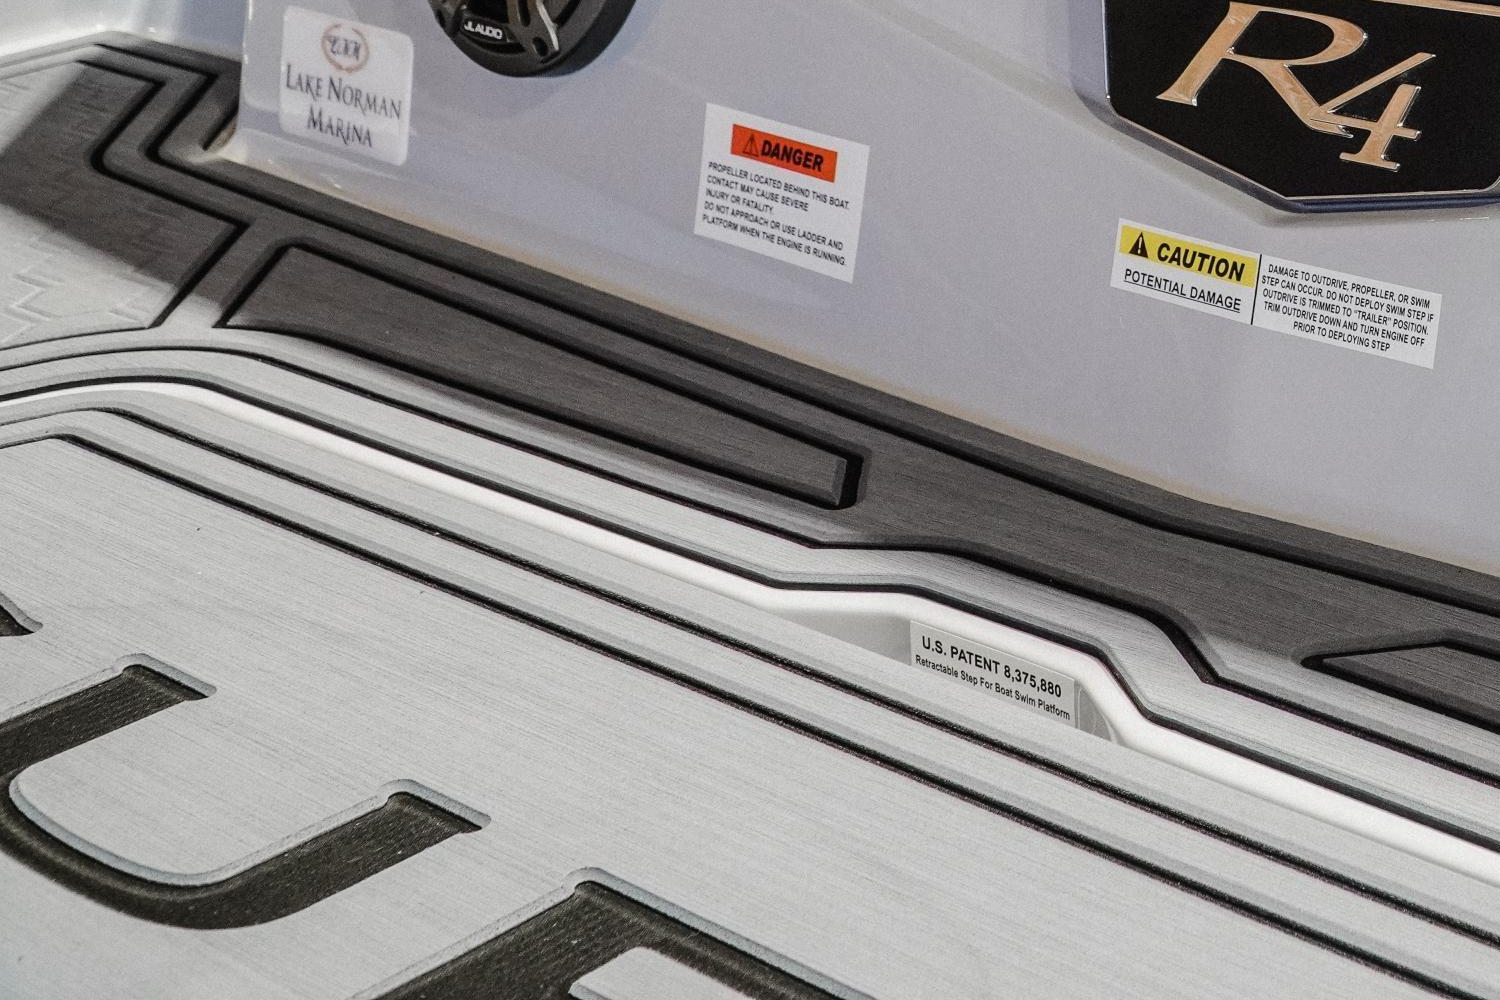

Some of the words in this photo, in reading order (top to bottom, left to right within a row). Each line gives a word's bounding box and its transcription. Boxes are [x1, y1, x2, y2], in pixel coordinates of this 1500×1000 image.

[287, 64, 322, 101] LAKE
[328, 76, 401, 120] NORMAN
[1157, 0, 1435, 171] R4
[308, 106, 372, 148] MARINA
[761, 140, 823, 172] DANGER
[706, 188, 729, 202] INJURY
[731, 196, 740, 205] OR
[707, 175, 738, 191] CONTACT
[740, 185, 754, 195] MAY
[756, 189, 779, 203] CAUSE
[781, 196, 808, 211] SEVERE
[708, 161, 748, 180] PROPELLER
[750, 174, 782, 189] LOCATED
[784, 183, 810, 198] BEHIND
[812, 192, 827, 203] THIS
[830, 197, 849, 209] BOAT.
[703, 214, 738, 231] PLATFORM
[740, 225, 760, 238] WHEN
[762, 231, 775, 243] THE
[777, 235, 802, 252] ENGINE
[804, 243, 811, 254] IS
[704, 201, 713, 210] DO
[716, 204, 729, 215] NOT
[731, 209, 768, 226] APPROACH
[770, 220, 780, 230] OR
[782, 224, 795, 235] USE
[798, 228, 826, 244] LADDER
[828, 237, 843, 251] AND
[1157, 243, 1245, 282] CAUTION
[1124, 269, 1186, 297] POTENTIAL
[1189, 287, 1241, 311] DAMAGE
[1262, 275, 1279, 288] STEP
[1281, 280, 1295, 292] CAN
[1298, 284, 1324, 298] OCCUR.
[1326, 290, 1337, 300] DO
[1338, 293, 1353, 305] NOT
[1354, 296, 1383, 312] DEPLOY
[1386, 303, 1405, 316] SWIM
[1407, 308, 1426, 320] STEP
[1428, 313, 1434, 322] IF
[1268, 264, 1298, 280] DAMAGE
[1301, 271, 1310, 281] TO
[1311, 274, 1349, 291] OUTDRIVE,
[1351, 282, 1396, 302] PROPELLER,
[1398, 293, 1408, 303] OR
[1410, 296, 1430, 308] SWIM
[1263, 289, 1297, 305] OUTDRIVE
[1299, 297, 1306, 307] IS
[1308, 299, 1340, 316] TRIMMED
[1342, 307, 1351, 317] TO
[1394, 318, 1428, 335] POSITION.
[1264, 302, 1280, 314] TRIM
[1282, 305, 1317, 322] OUTDRIVE
[1319, 314, 1341, 328] DOWN
[1343, 320, 1357, 332] AND
[1360, 323, 1379, 336] TURN
[1381, 328, 1408, 344] ENGINE
[1410, 336, 1425, 347] OFF
[1293, 321, 1315, 335] PRIOR
[1317, 327, 1327, 337] TO
[1328, 329, 1369, 348] DEPLOYING
[1371, 339, 1390, 352] STEP
[916, 655, 958, 677] Retractable
[961, 671, 978, 686] Step
[980, 678, 993, 690] For
[995, 683, 1012, 697] Boat
[1015, 690, 1036, 706] Swim
[1038, 699, 1070, 720] Platform
[922, 636, 946, 655] U.S.
[951, 646, 1000, 673] PATENT
[1004, 665, 1061, 697] 8,375,880
